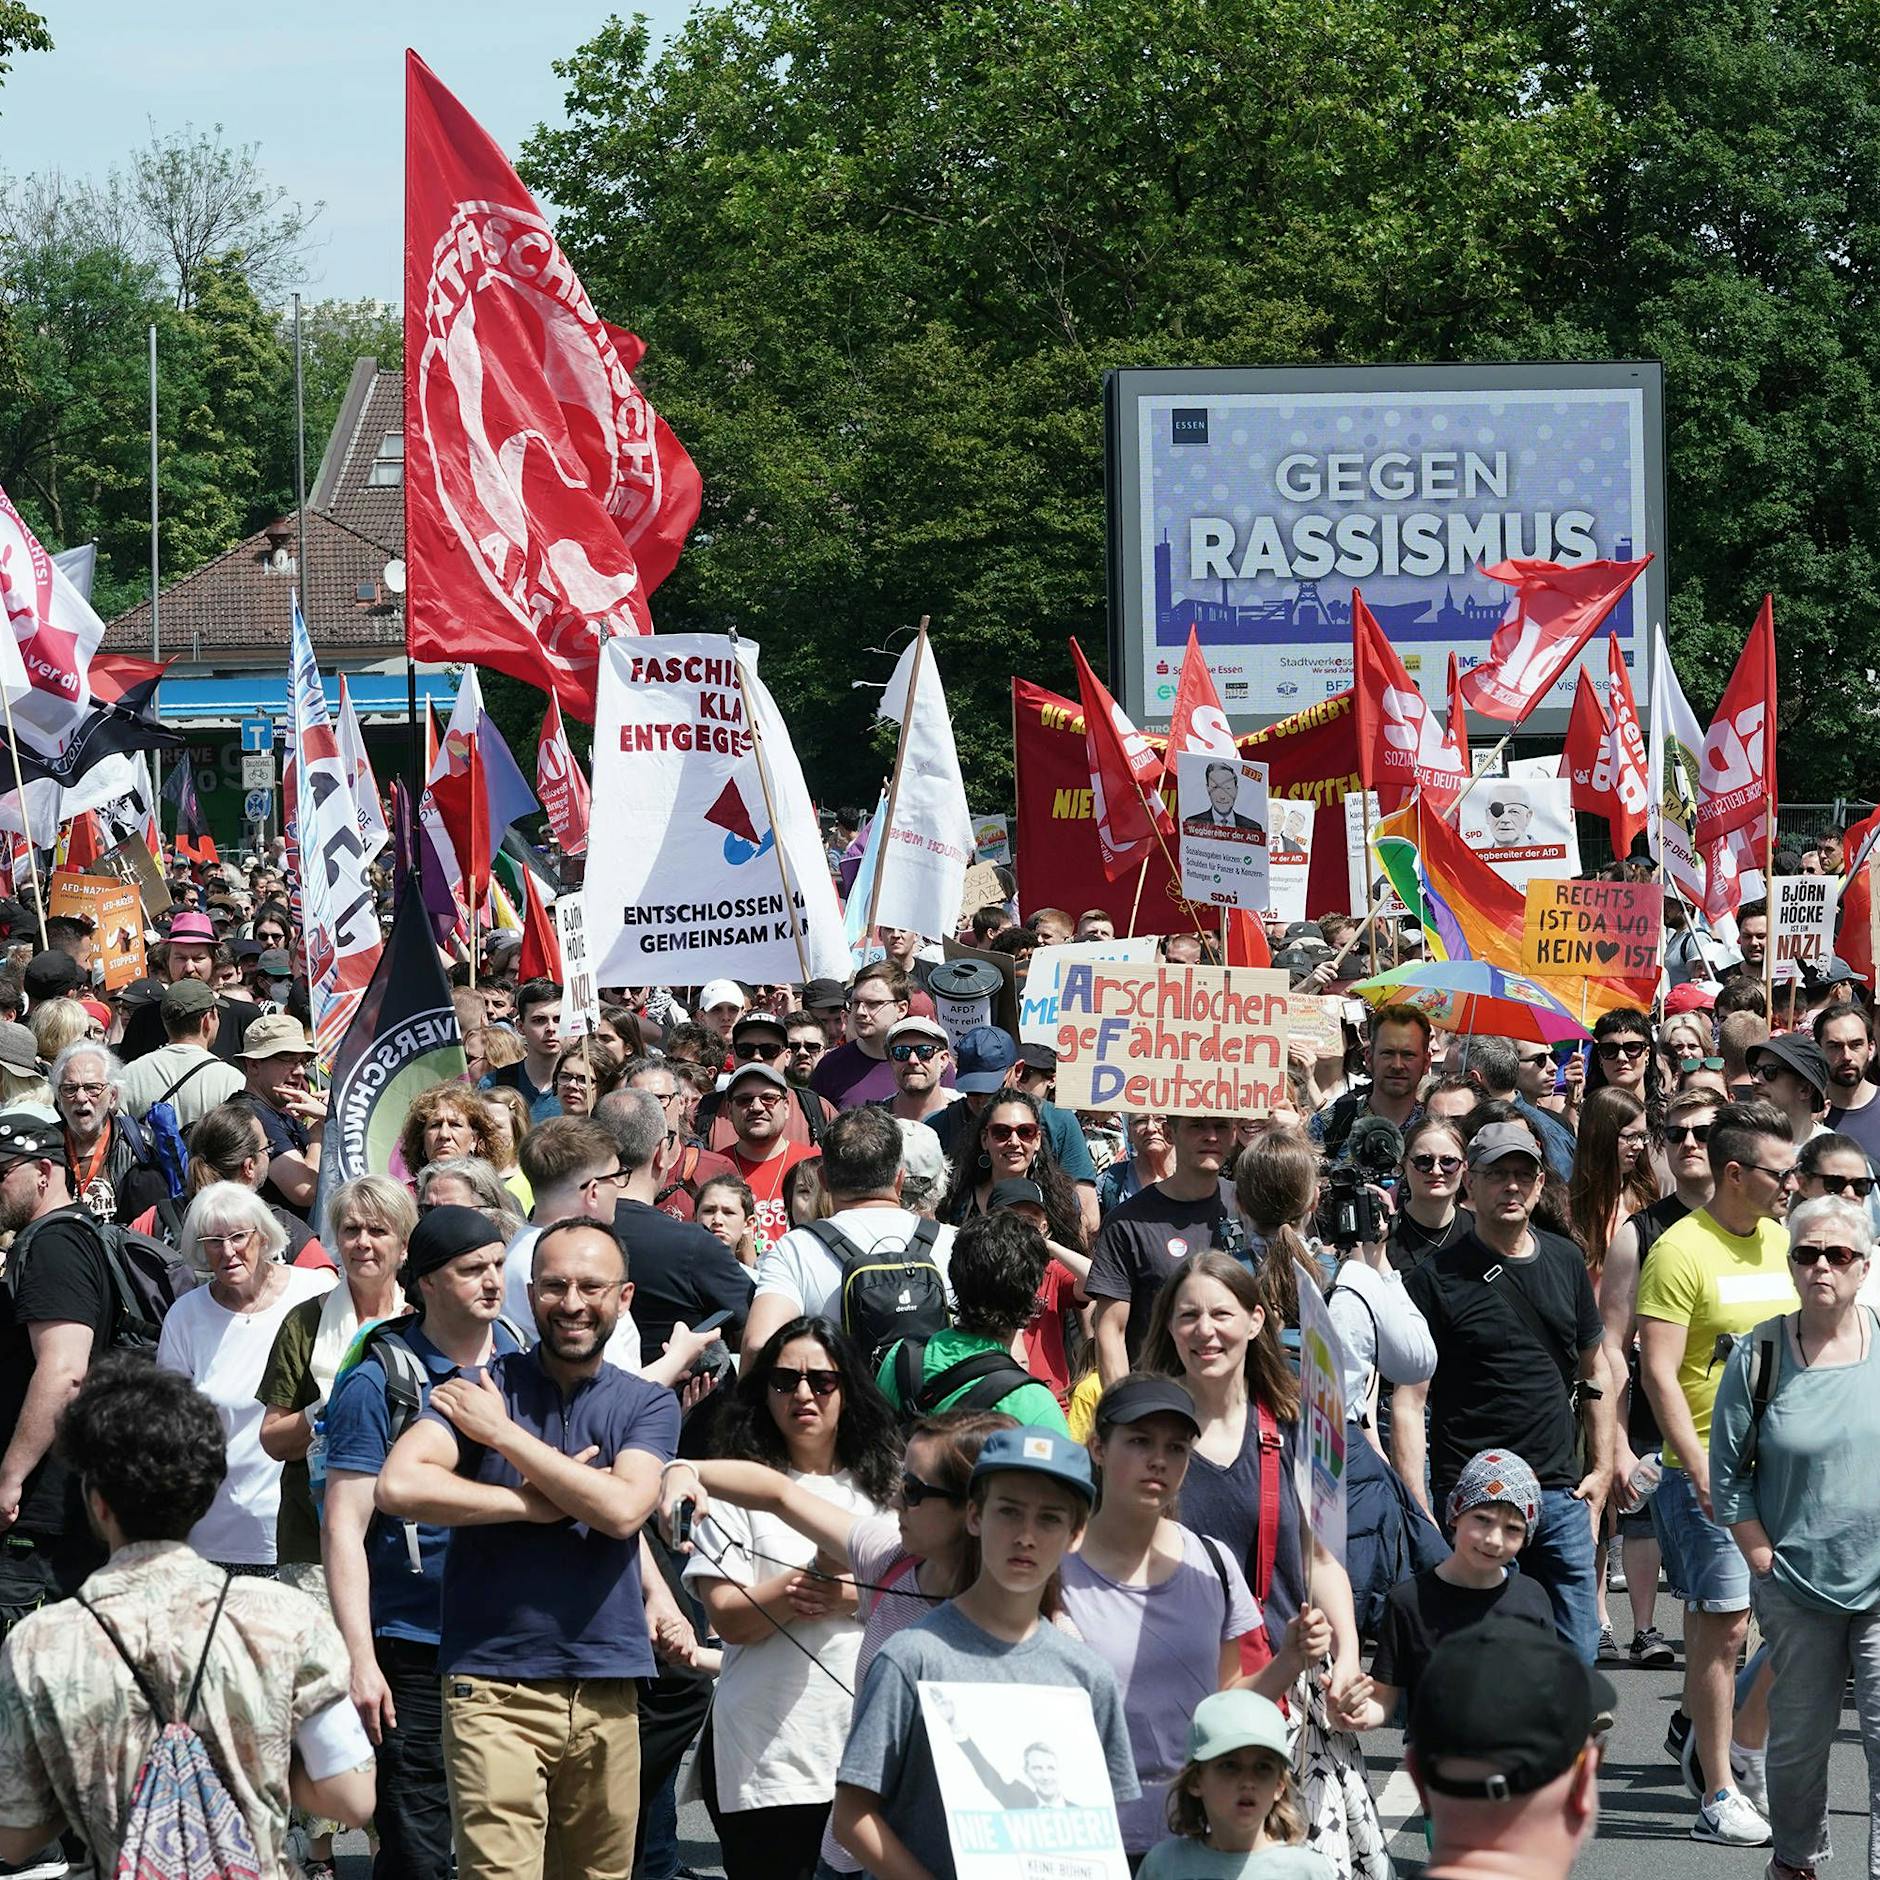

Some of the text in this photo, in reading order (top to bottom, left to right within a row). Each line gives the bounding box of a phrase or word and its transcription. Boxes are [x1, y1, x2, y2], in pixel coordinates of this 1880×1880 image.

[1175, 421, 1205, 430] ESSEN
[1275, 450, 1508, 503] GEGEN
[1189, 510, 1598, 581] RASSISMUS
[630, 656, 741, 690] FASCHIS
[1218, 664, 1244, 674] Essen
[1041, 703, 1072, 730] DIE
[1274, 697, 1351, 738] SCHIEBT
[1144, 724, 1170, 733] STRÖ
[40, 736, 83, 772] AKTION
[1188, 825, 1260, 843] Wegbereiter der AfD
[1464, 830, 1483, 840] SPD
[1525, 850, 1540, 858] der
[1542, 848, 1559, 857] AfD
[1217, 863, 1234, 874] Panzer
[1556, 884, 1635, 909] RECHTS
[1782, 881, 1826, 902] BJÖRN
[102, 895, 135, 912] AFD-NAZIS
[624, 894, 783, 925] ENTSCHLOSSEN
[1780, 903, 1824, 925] HÖCKE
[1539, 909, 1649, 937] IST DA WO
[1791, 924, 1799, 932] IST
[640, 925, 768, 954] GEMEINSAM
[1776, 933, 1821, 960] NAZI
[109, 953, 140, 970] STOPPEN!
[1537, 938, 1658, 968] KEIN IST
[1060, 964, 1289, 1027] Arschlöcher
[942, 1013, 984, 1025] hier rein!
[950, 1004, 976, 1014] AFD?
[1057, 1018, 1281, 1069] geFährden
[1091, 1064, 1286, 1112] Deutschland
[895, 1304, 918, 1313] deuter
[956, 1808, 1117, 1850] NIE WIEDER!
[1028, 1859, 1054, 1874] KEINE
